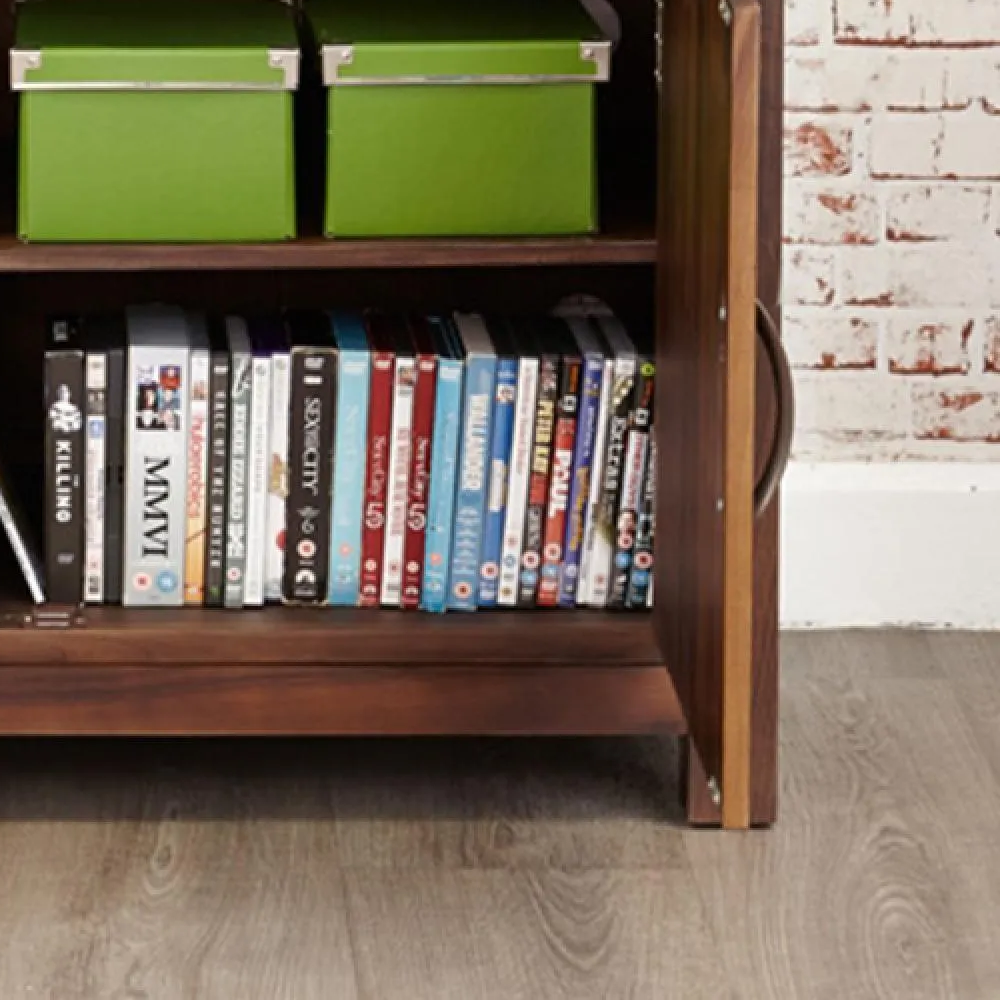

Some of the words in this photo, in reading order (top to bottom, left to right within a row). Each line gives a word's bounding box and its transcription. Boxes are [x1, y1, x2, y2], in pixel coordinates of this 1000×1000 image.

[303, 396, 321, 430] SEX
[461, 393, 489, 491] WALLANDER
[535, 399, 555, 444] PETER
[55, 439, 73, 524] KILLING
[301, 447, 321, 496] CITY
[532, 445, 552, 474] KAY
[548, 450, 573, 519] PAUL
[602, 415, 628, 491] Extras
[141, 455, 171, 559] MMVI
